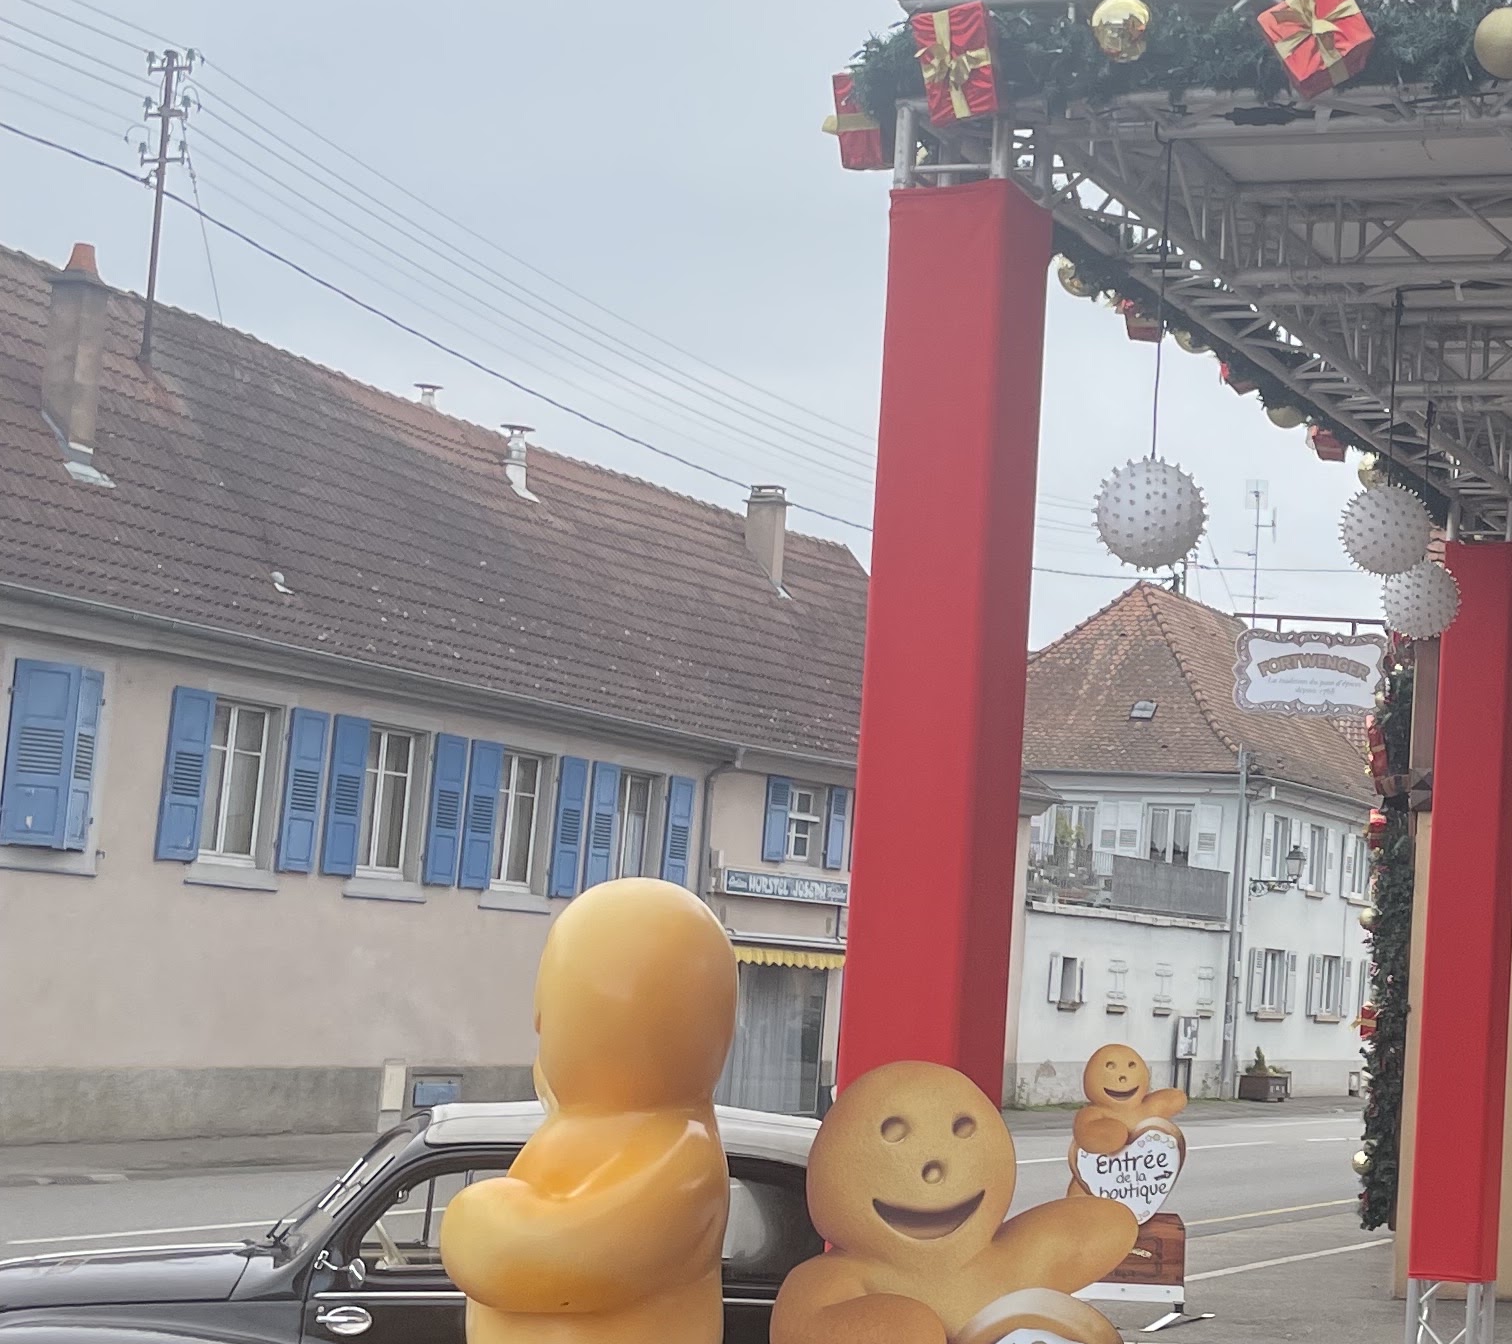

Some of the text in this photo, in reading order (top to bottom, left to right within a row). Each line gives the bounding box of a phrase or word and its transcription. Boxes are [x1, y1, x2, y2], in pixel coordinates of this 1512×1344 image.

[1257, 653, 1371, 682] FORTWENGER
[1096, 1150, 1168, 1174] Entrée
[1116, 1171, 1147, 1184] de la
[1099, 1182, 1168, 1204] boutique
